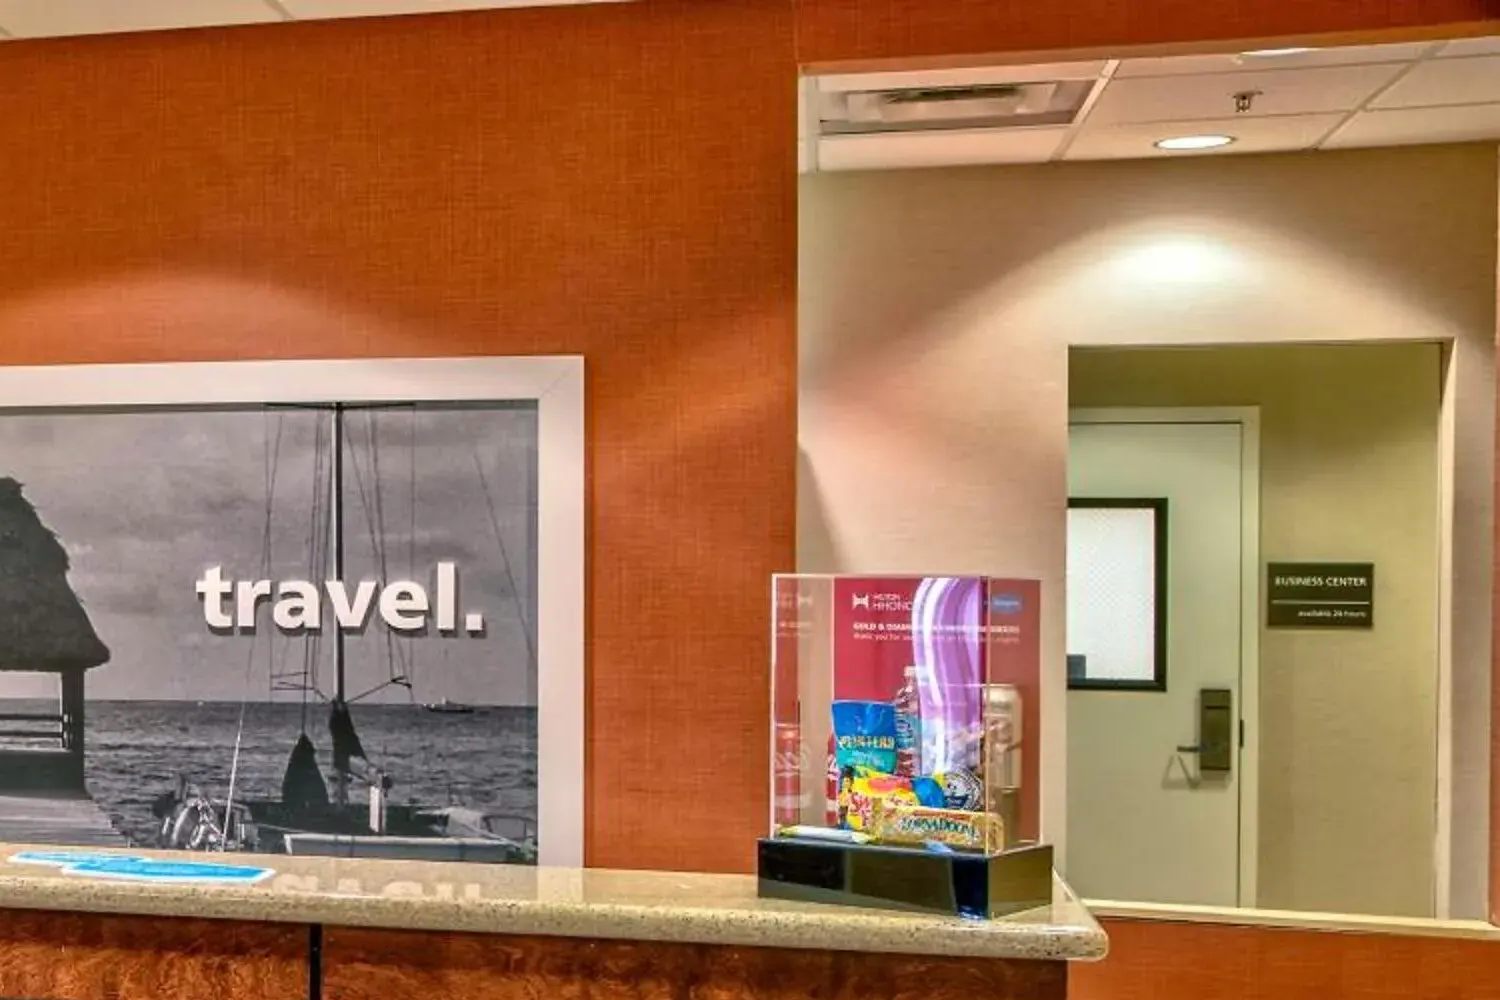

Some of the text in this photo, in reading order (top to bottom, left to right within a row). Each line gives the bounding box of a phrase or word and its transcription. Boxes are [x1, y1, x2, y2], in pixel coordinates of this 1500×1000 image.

[196, 562, 485, 634] travel.
[1274, 576, 1367, 587] BUSINESS CENTER
